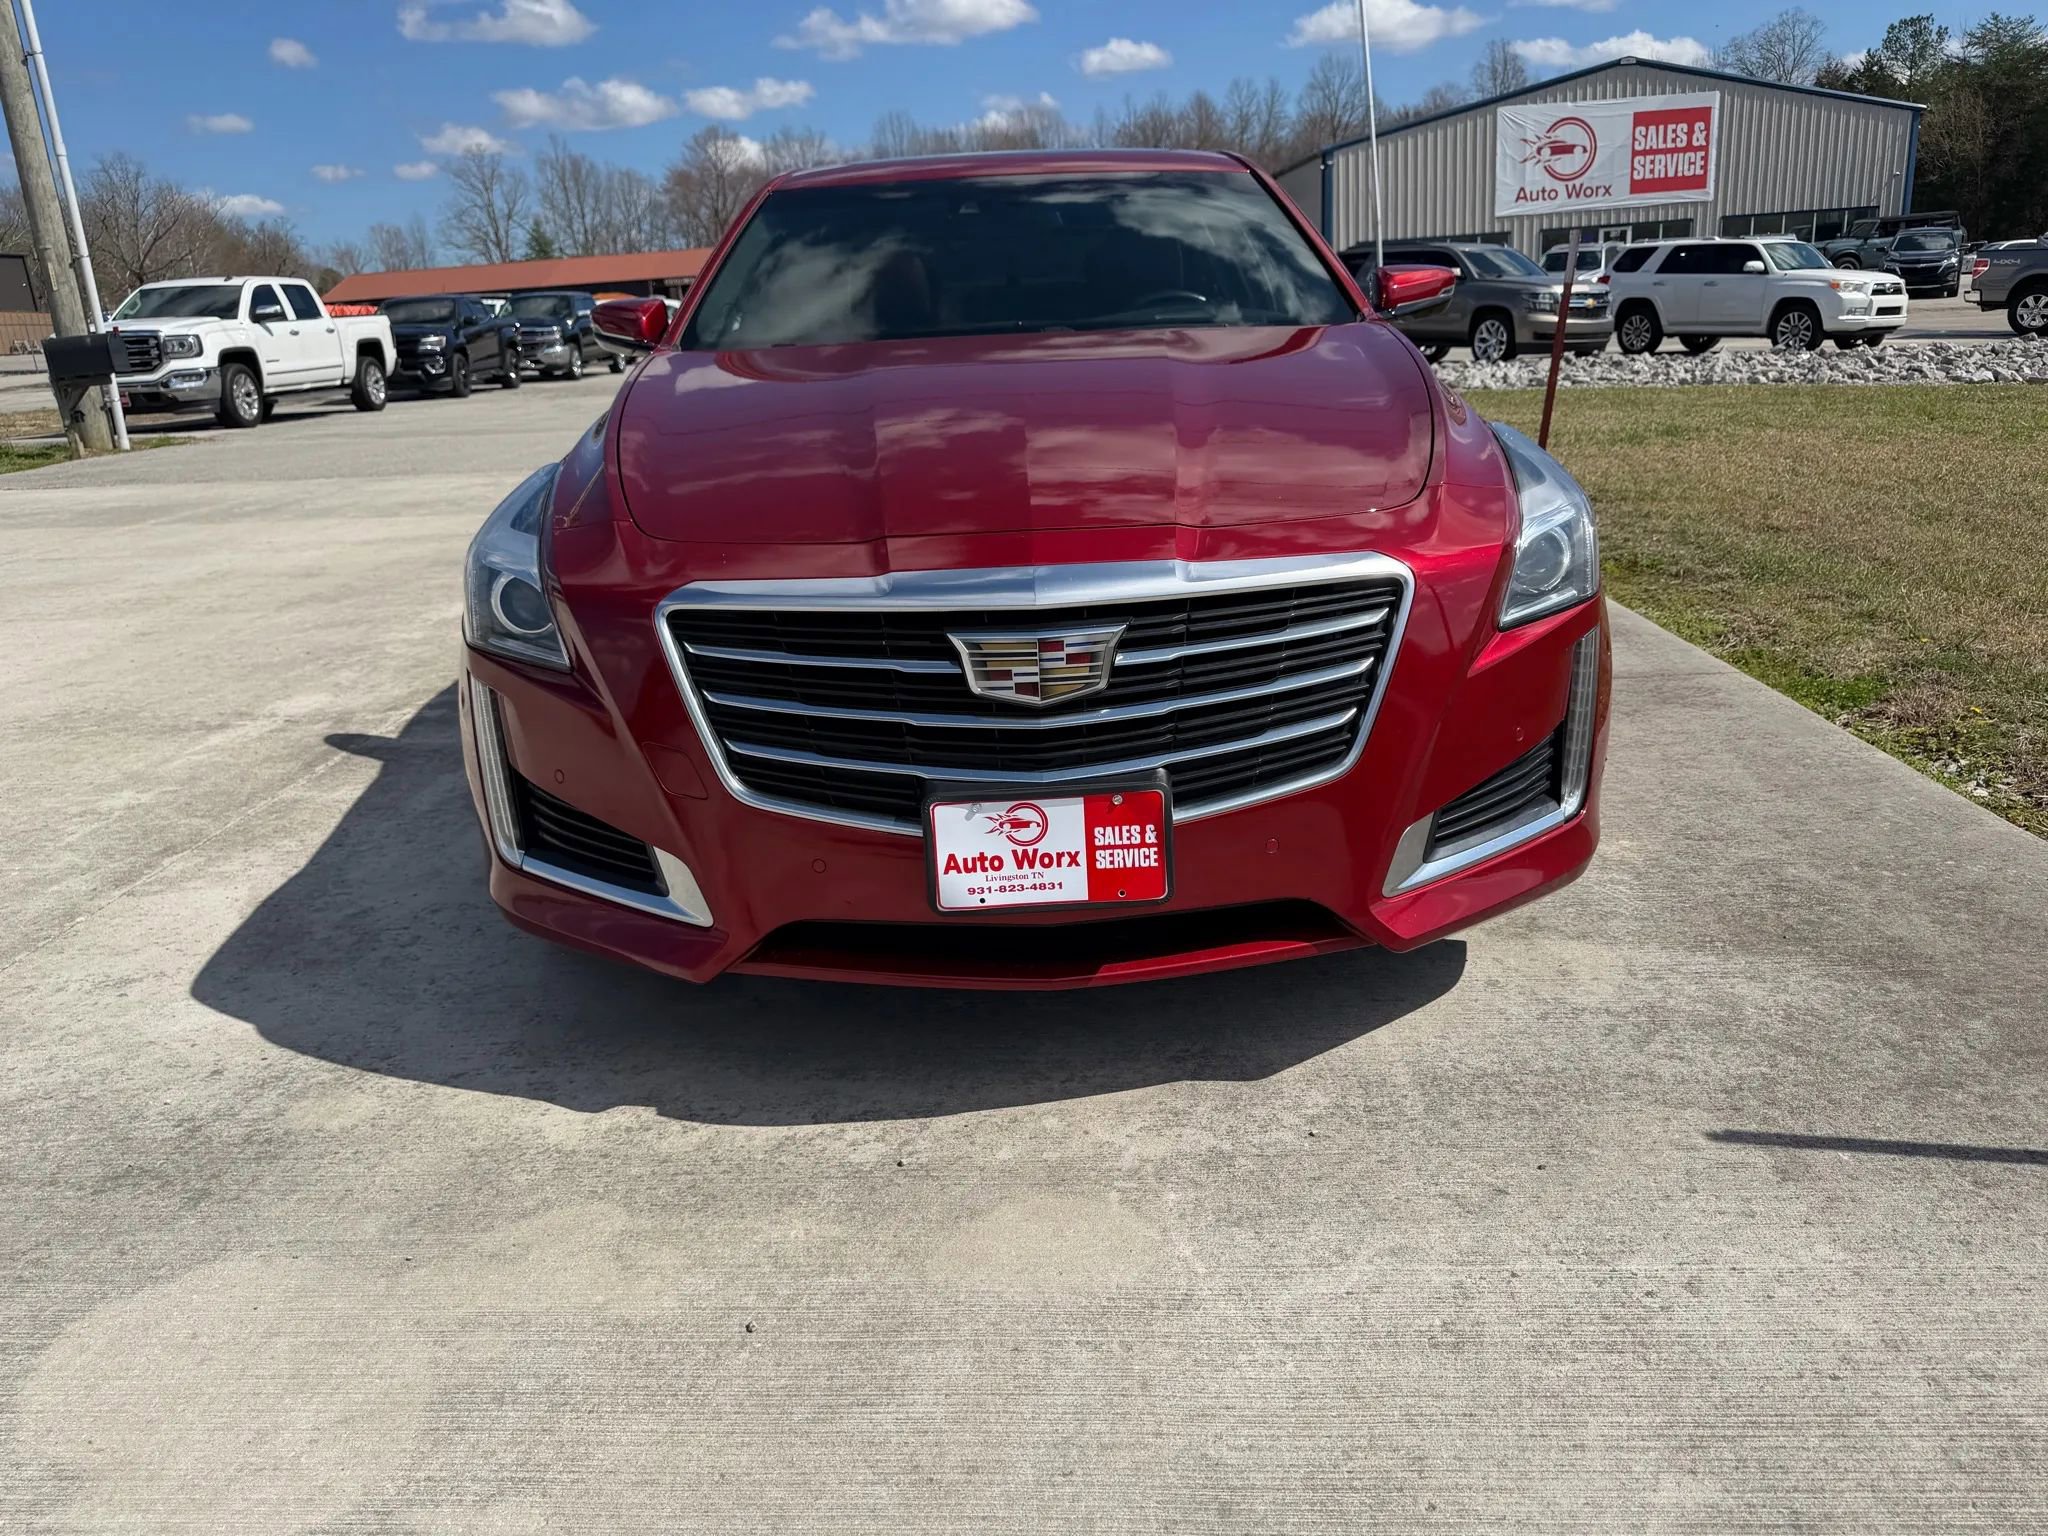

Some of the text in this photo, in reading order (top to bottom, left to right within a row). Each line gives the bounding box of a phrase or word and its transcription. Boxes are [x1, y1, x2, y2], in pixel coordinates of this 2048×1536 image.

[1634, 121, 1707, 151] SALES &
[1633, 151, 1705, 180] SERVICE
[1515, 183, 1612, 203] Auto Worx
[1094, 824, 1157, 846] SALES &
[943, 848, 1081, 875] Auto Worx
[1095, 847, 1159, 869] SERVICE
[985, 871, 1044, 883] Livingston TN
[967, 882, 1063, 895] 931-823-4831
